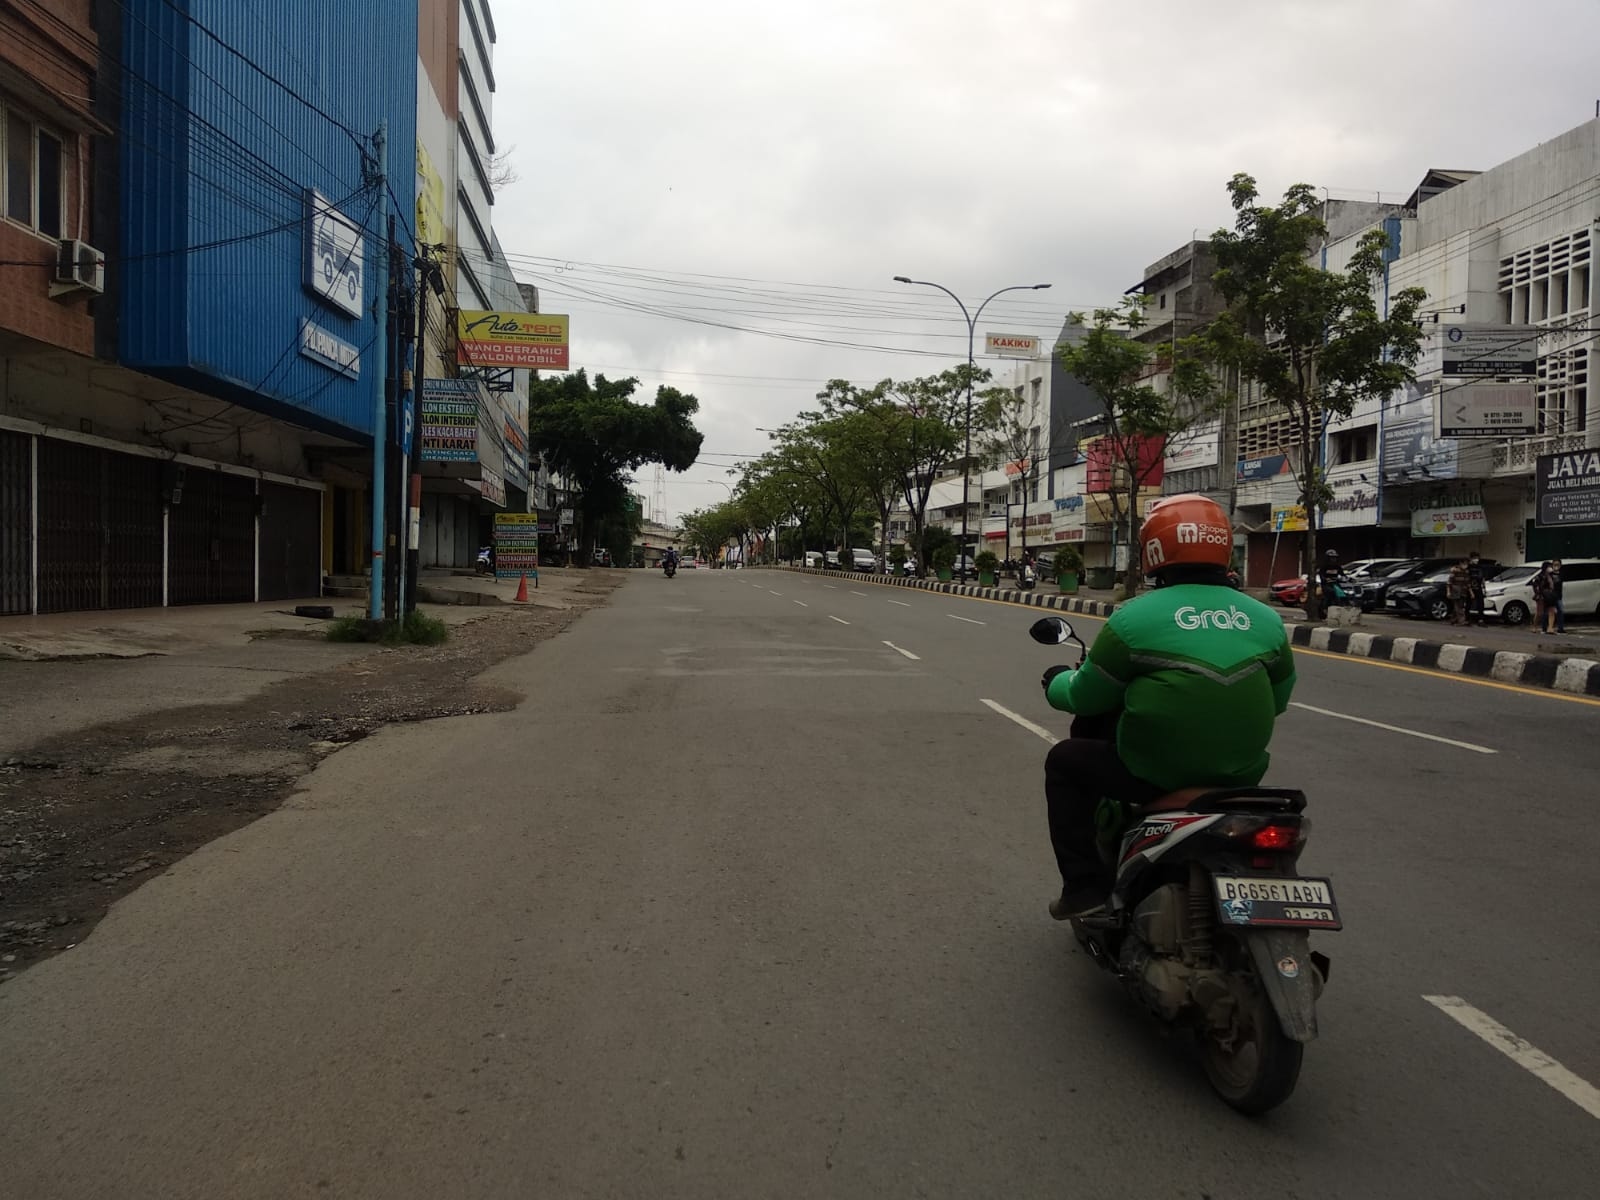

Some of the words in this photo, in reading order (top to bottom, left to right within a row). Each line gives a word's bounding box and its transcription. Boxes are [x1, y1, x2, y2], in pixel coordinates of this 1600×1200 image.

[992, 337, 1031, 348] KAKIKU
[463, 343, 502, 352] NANO
[504, 345, 562, 355] CERAMIC
[470, 352, 514, 362] SALON
[517, 355, 557, 363] MOBIL
[441, 415, 476, 426] INTERIOR
[437, 427, 455, 438] KACA
[455, 428, 476, 438] BARET
[423, 438, 440, 448] NTI
[440, 439, 476, 450] KARAT
[1548, 453, 1600, 478] JAYA
[1547, 480, 1564, 489] JUAL
[1565, 478, 1580, 488] BELI
[1199, 523, 1228, 534] Shopee
[1199, 532, 1228, 546] Food
[1174, 604, 1251, 631] Grab
